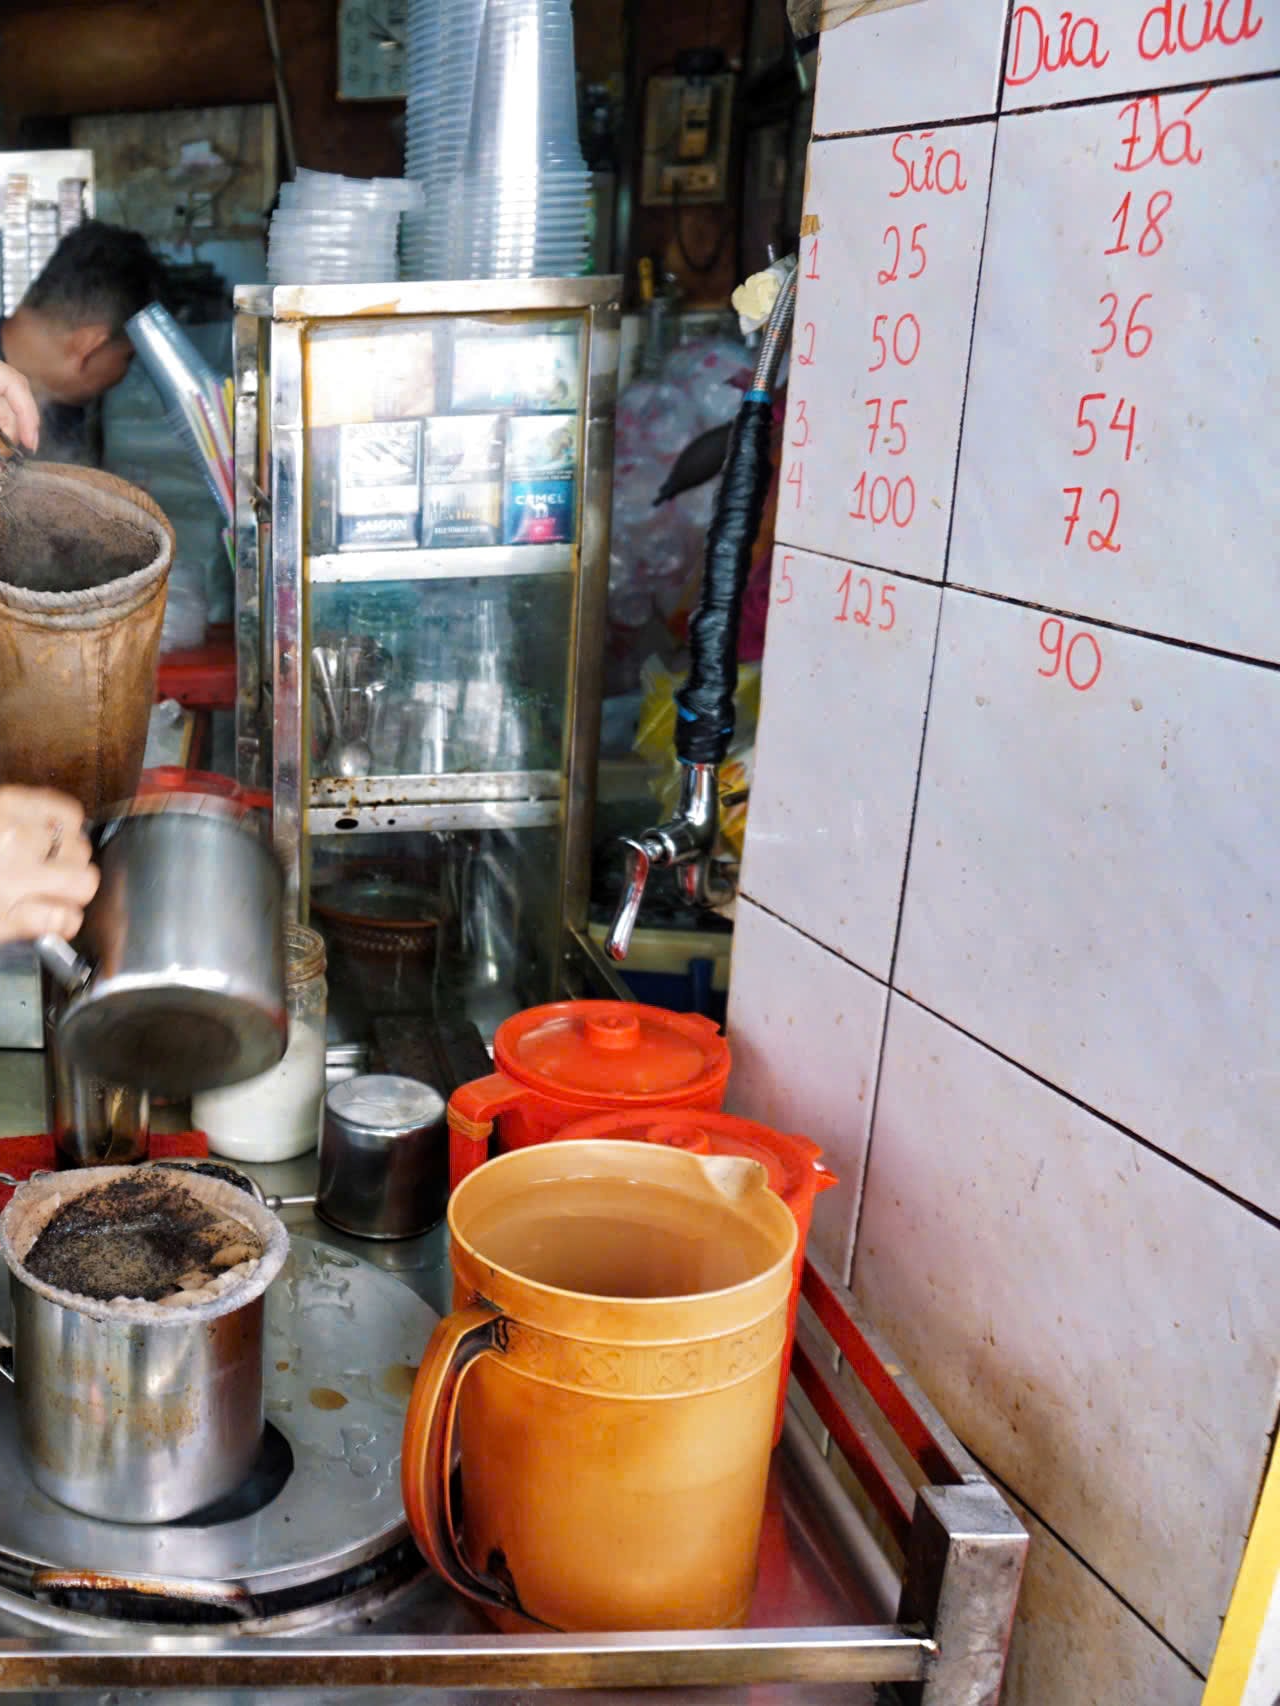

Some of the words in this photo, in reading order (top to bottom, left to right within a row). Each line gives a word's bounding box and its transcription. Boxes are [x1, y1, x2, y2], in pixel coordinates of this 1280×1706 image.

[888, 130, 968, 198] Sữa
[1113, 85, 1216, 172] Đá
[805, 238, 821, 281] 1
[877, 223, 928, 285] 25
[1104, 189, 1174, 257] 18
[797, 322, 816, 366] 2
[868, 312, 921, 373] 50
[1091, 292, 1154, 359] 36
[791, 399, 810, 448] 3
[865, 398, 909, 456] 75
[1072, 392, 1138, 461] 54
[514, 493, 566, 505] CAMEL
[786, 461, 804, 509] 4
[849, 471, 917, 528] 100
[1062, 486, 1122, 553] 72
[775, 555, 795, 605] 5
[834, 567, 897, 631] 125
[1037, 617, 1103, 692] 90
